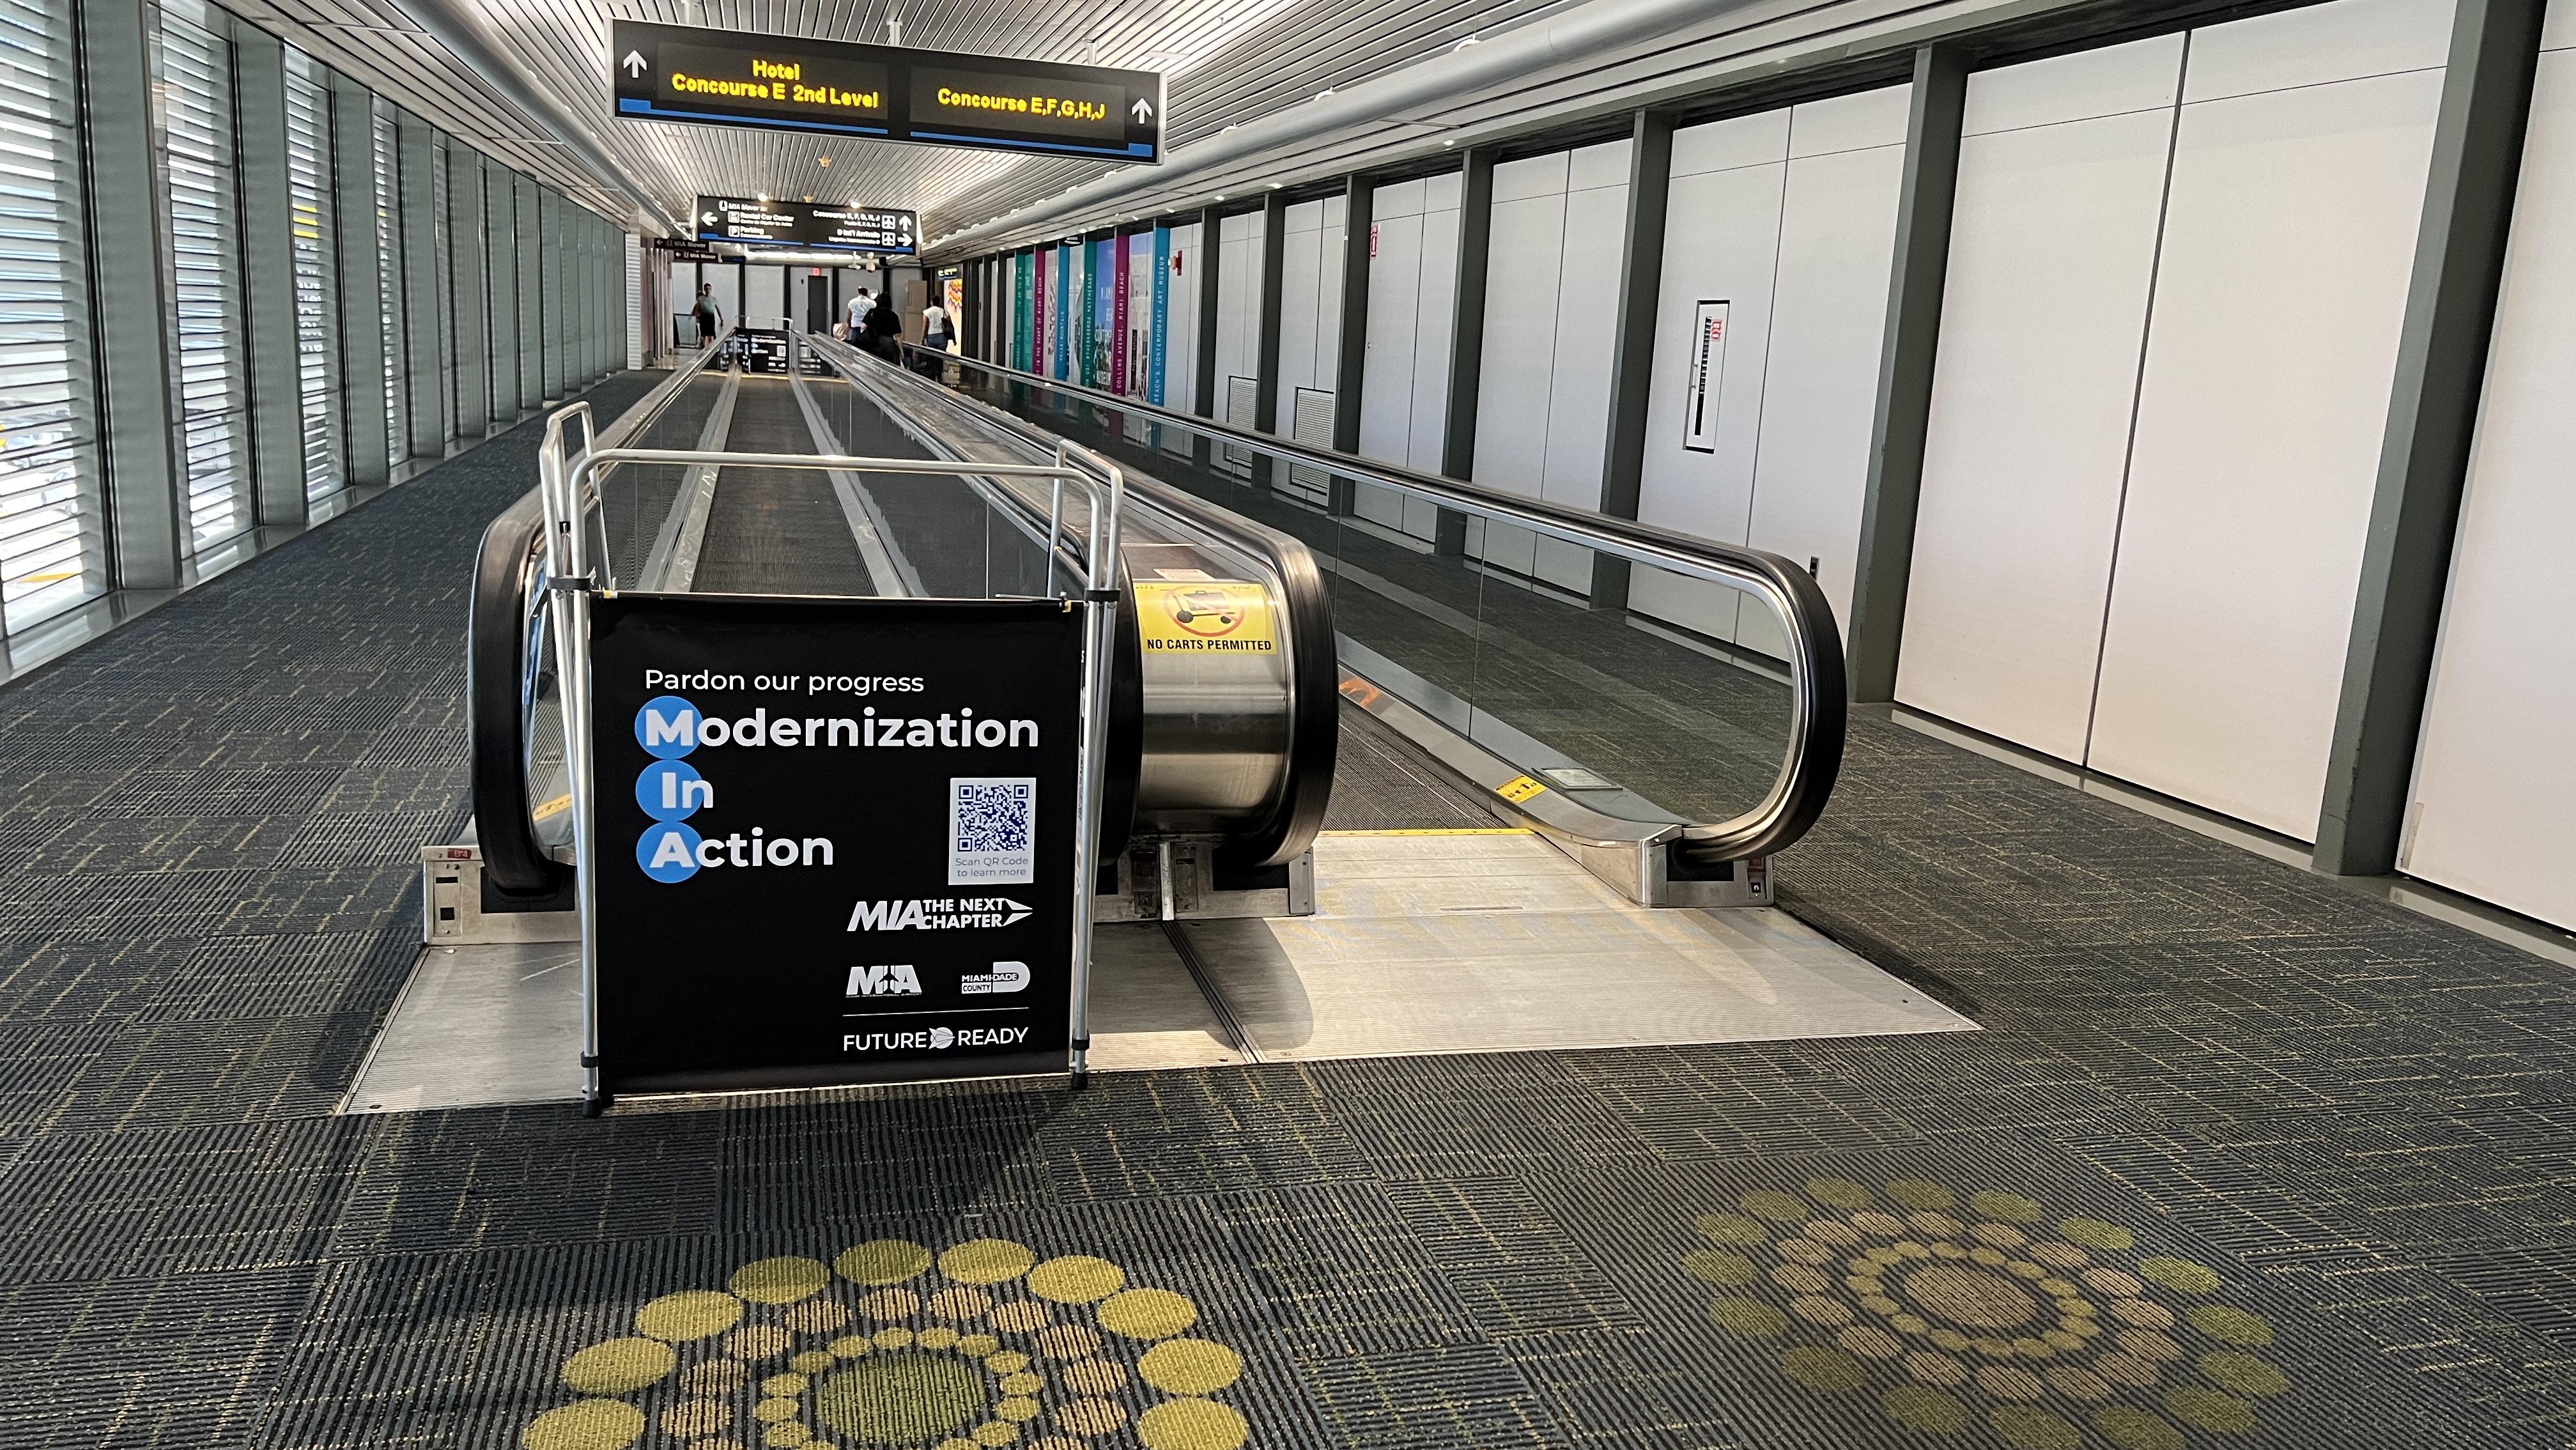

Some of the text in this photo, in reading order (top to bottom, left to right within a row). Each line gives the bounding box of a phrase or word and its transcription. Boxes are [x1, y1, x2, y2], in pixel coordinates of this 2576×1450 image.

[752, 59, 800, 81] Hotel
[672, 73, 879, 108] Concourse E 2nd Level
[937, 88, 1106, 121] Concourse E,F,G,H,J
[1147, 639, 1272, 651] NO CARTS PERMITTED
[645, 669, 924, 696] Pardon our progress
[645, 706, 1039, 748] Modernization
[661, 771, 714, 808] In
[649, 826, 833, 868] Action
[955, 857, 1029, 867] Scan QR Code
[971, 868, 996, 877] learn
[847, 898, 1005, 931] MIA THE NEXT
[923, 914, 1003, 929] CHAPTER
[962, 984, 991, 992] COUNTY
[844, 1026, 1030, 1051] FUTURE READY
